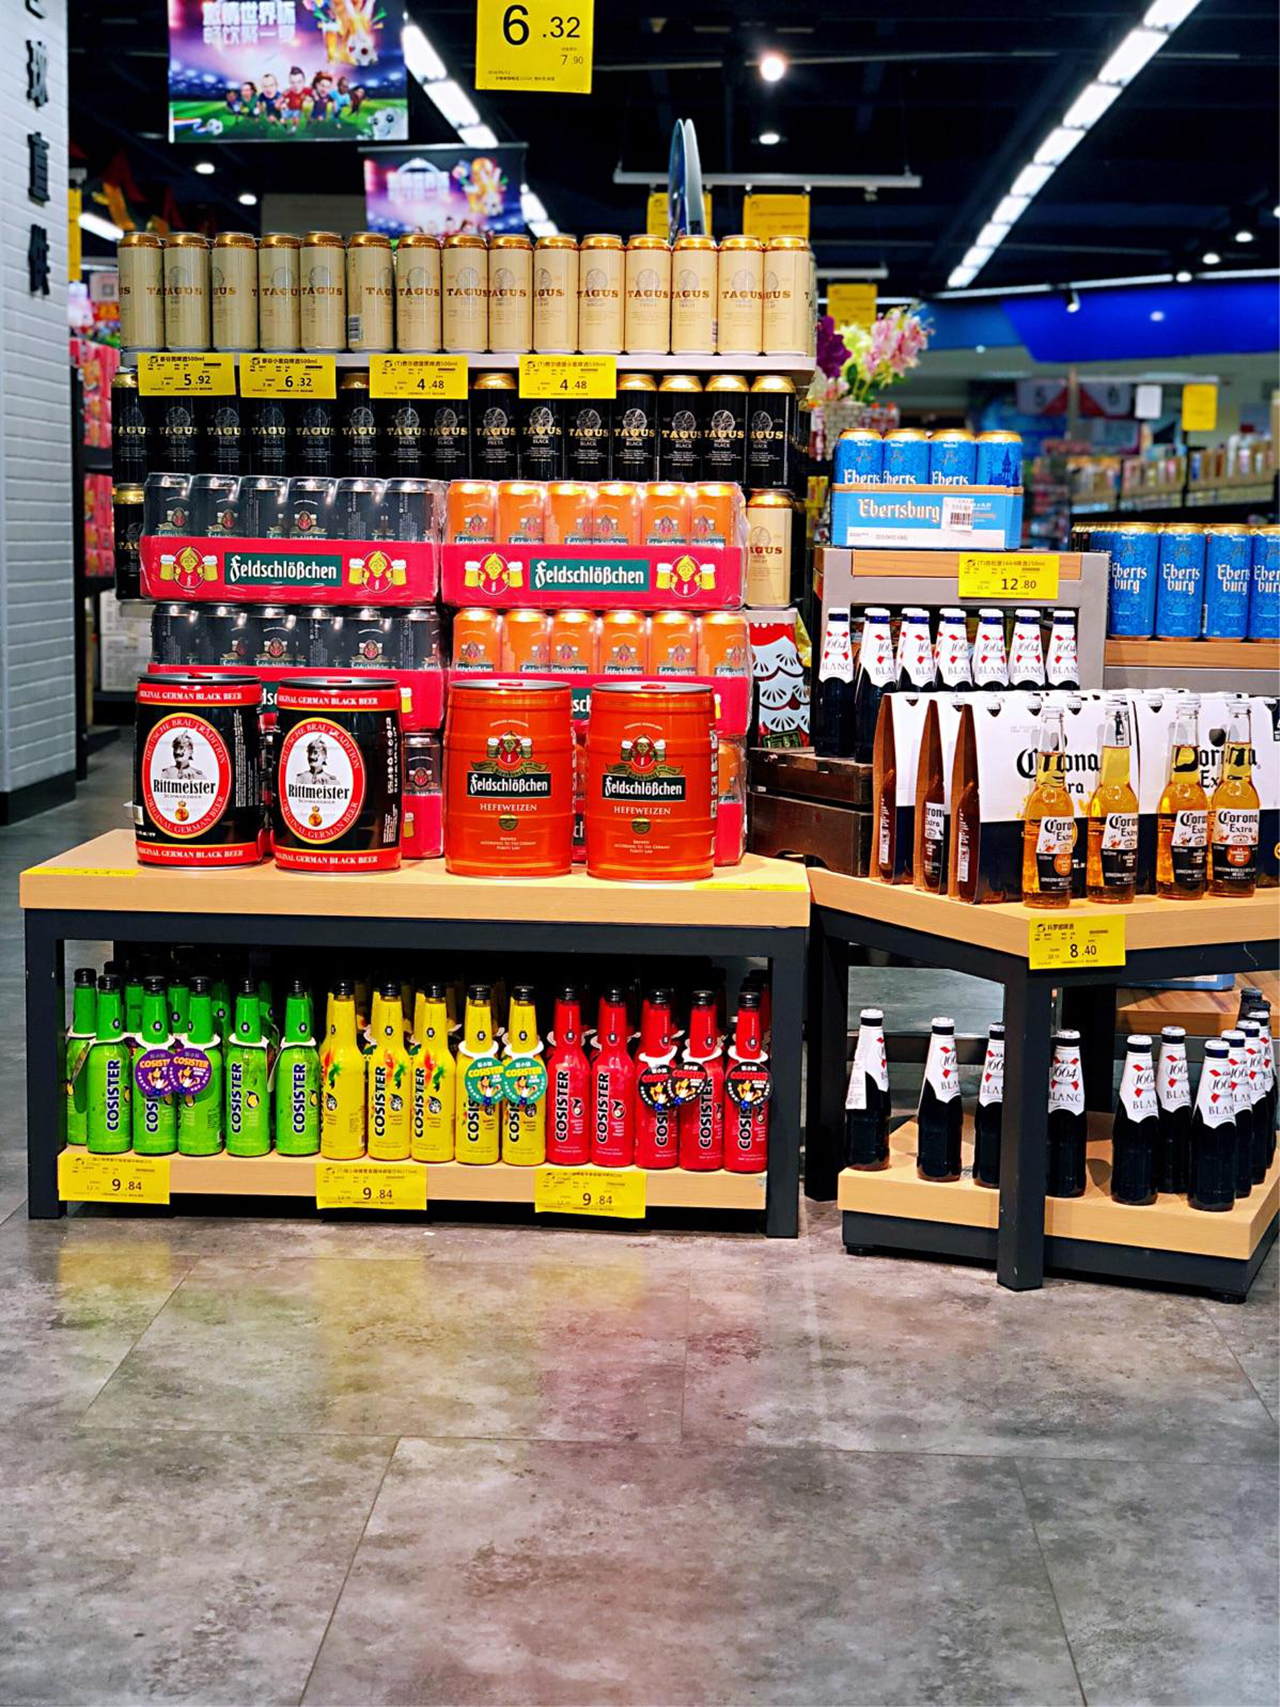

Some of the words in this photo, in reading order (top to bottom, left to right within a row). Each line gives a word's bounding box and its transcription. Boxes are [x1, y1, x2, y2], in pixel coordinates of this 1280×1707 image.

[398, 288, 440, 297] TAGUS
[628, 290, 668, 299] TAGUS
[722, 291, 763, 300] TAGUS
[475, 428, 516, 437] TAGUS
[568, 428, 609, 437] TAGUS
[614, 428, 655, 438] TAGUS
[705, 430, 744, 439] TAGUS
[857, 498, 941, 523] Ebertsburg
[230, 554, 337, 582] Feldschlößchen
[535, 560, 644, 588] Feldschlößchen
[1114, 576, 1140, 594] burg
[1167, 577, 1195, 595] burg
[153, 779, 216, 795] Rittmeister
[288, 784, 349, 800] Rittmeister
[470, 773, 548, 794] Feldschlößchen
[605, 776, 682, 797] Feldschlößchen
[480, 803, 537, 812] HEFEWEIZEN
[614, 806, 671, 815] HEFEWEIZEN
[106, 1059, 121, 1131] COSISTER
[231, 1062, 243, 1134] COSISTER
[292, 1063, 307, 1134] COSISTER
[375, 1066, 386, 1137] COSISTER
[415, 1068, 425, 1138] COSISTER
[555, 1070, 570, 1142] COSISTER
[597, 1072, 610, 1143] COSISTER
